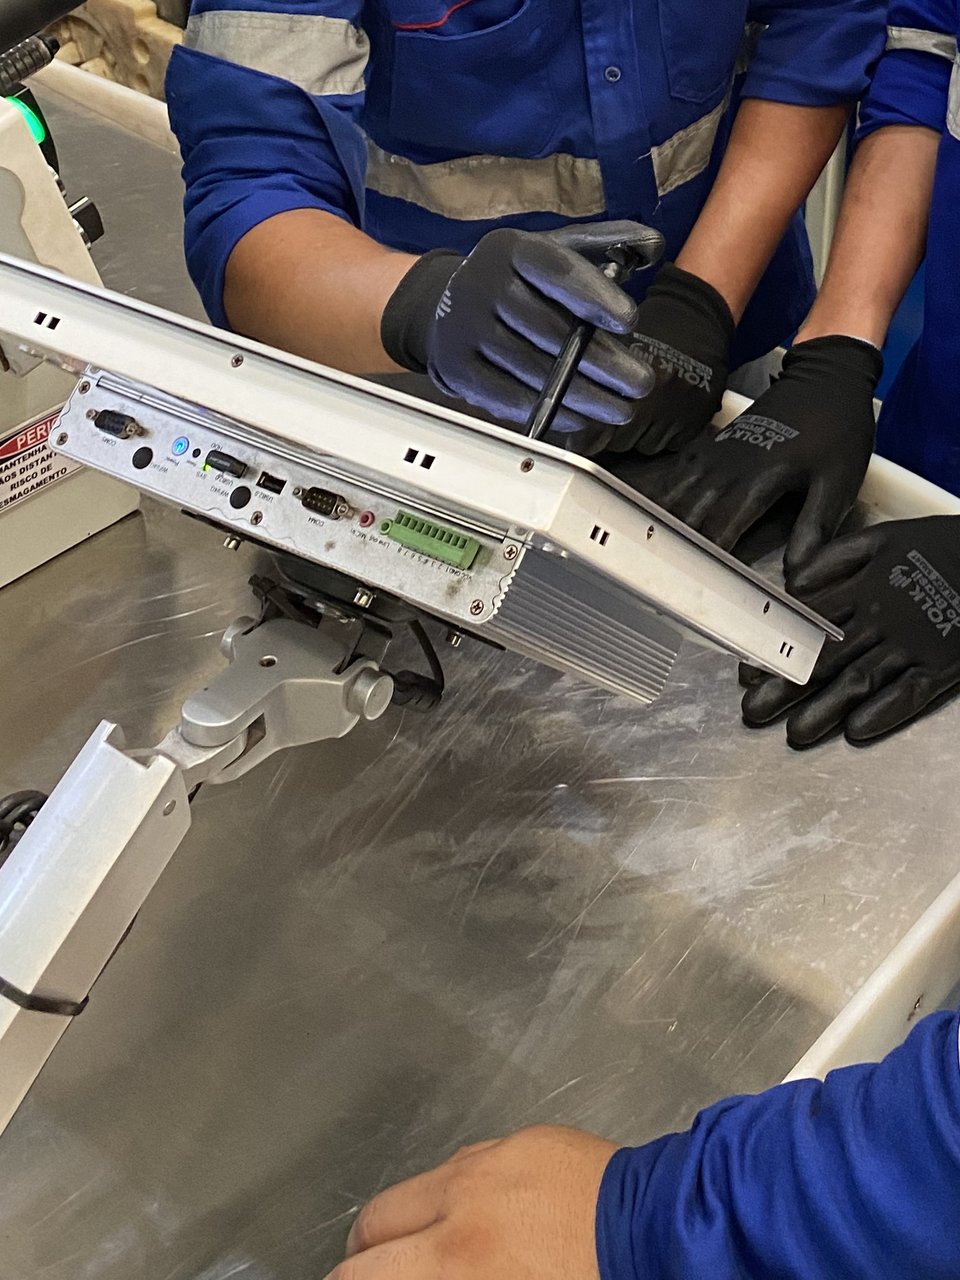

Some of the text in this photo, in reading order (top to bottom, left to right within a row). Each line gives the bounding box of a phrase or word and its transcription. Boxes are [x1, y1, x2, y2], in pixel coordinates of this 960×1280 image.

[17, 418, 58, 450] PERI
[730, 427, 775, 451] VOLK
[10, 463, 53, 491] RISCO DE
[911, 570, 948, 610] Brasil
[908, 584, 952, 637] VOLK
